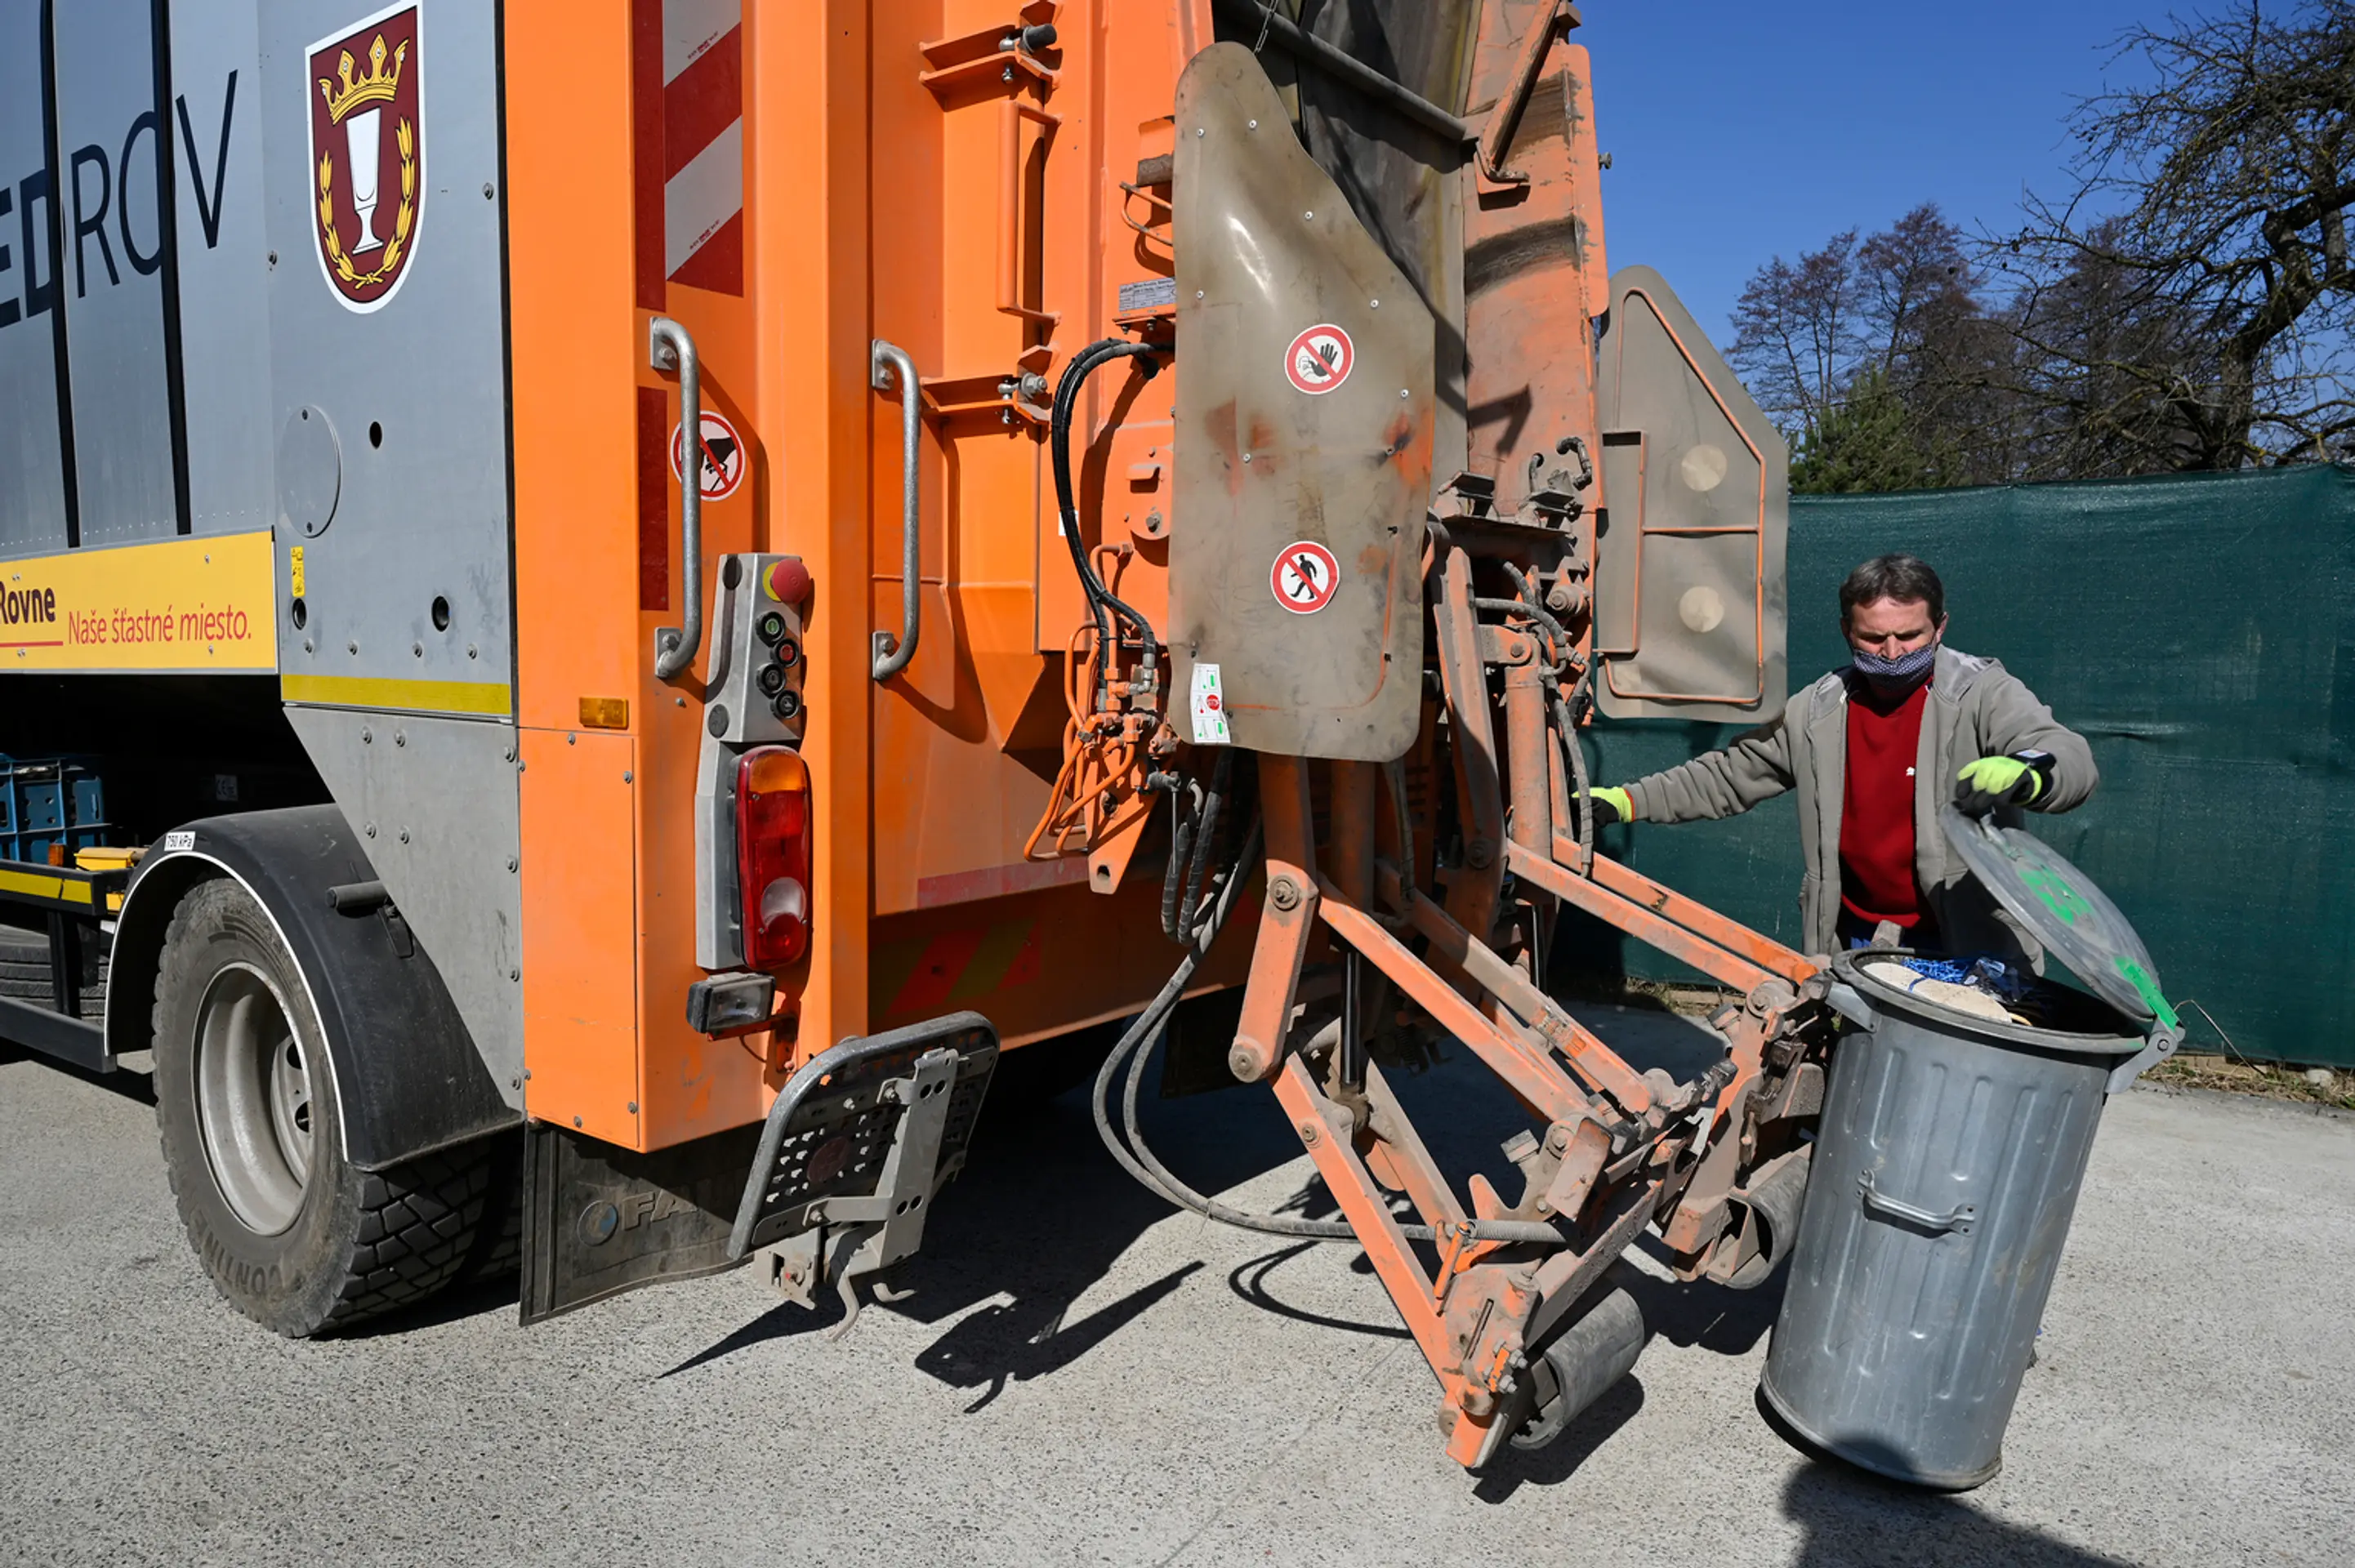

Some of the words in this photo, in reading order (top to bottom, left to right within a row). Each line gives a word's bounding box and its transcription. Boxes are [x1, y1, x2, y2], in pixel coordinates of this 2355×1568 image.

[69, 609, 107, 644] Naše
[111, 604, 174, 644] šťastné
[179, 602, 252, 641] miesto.
